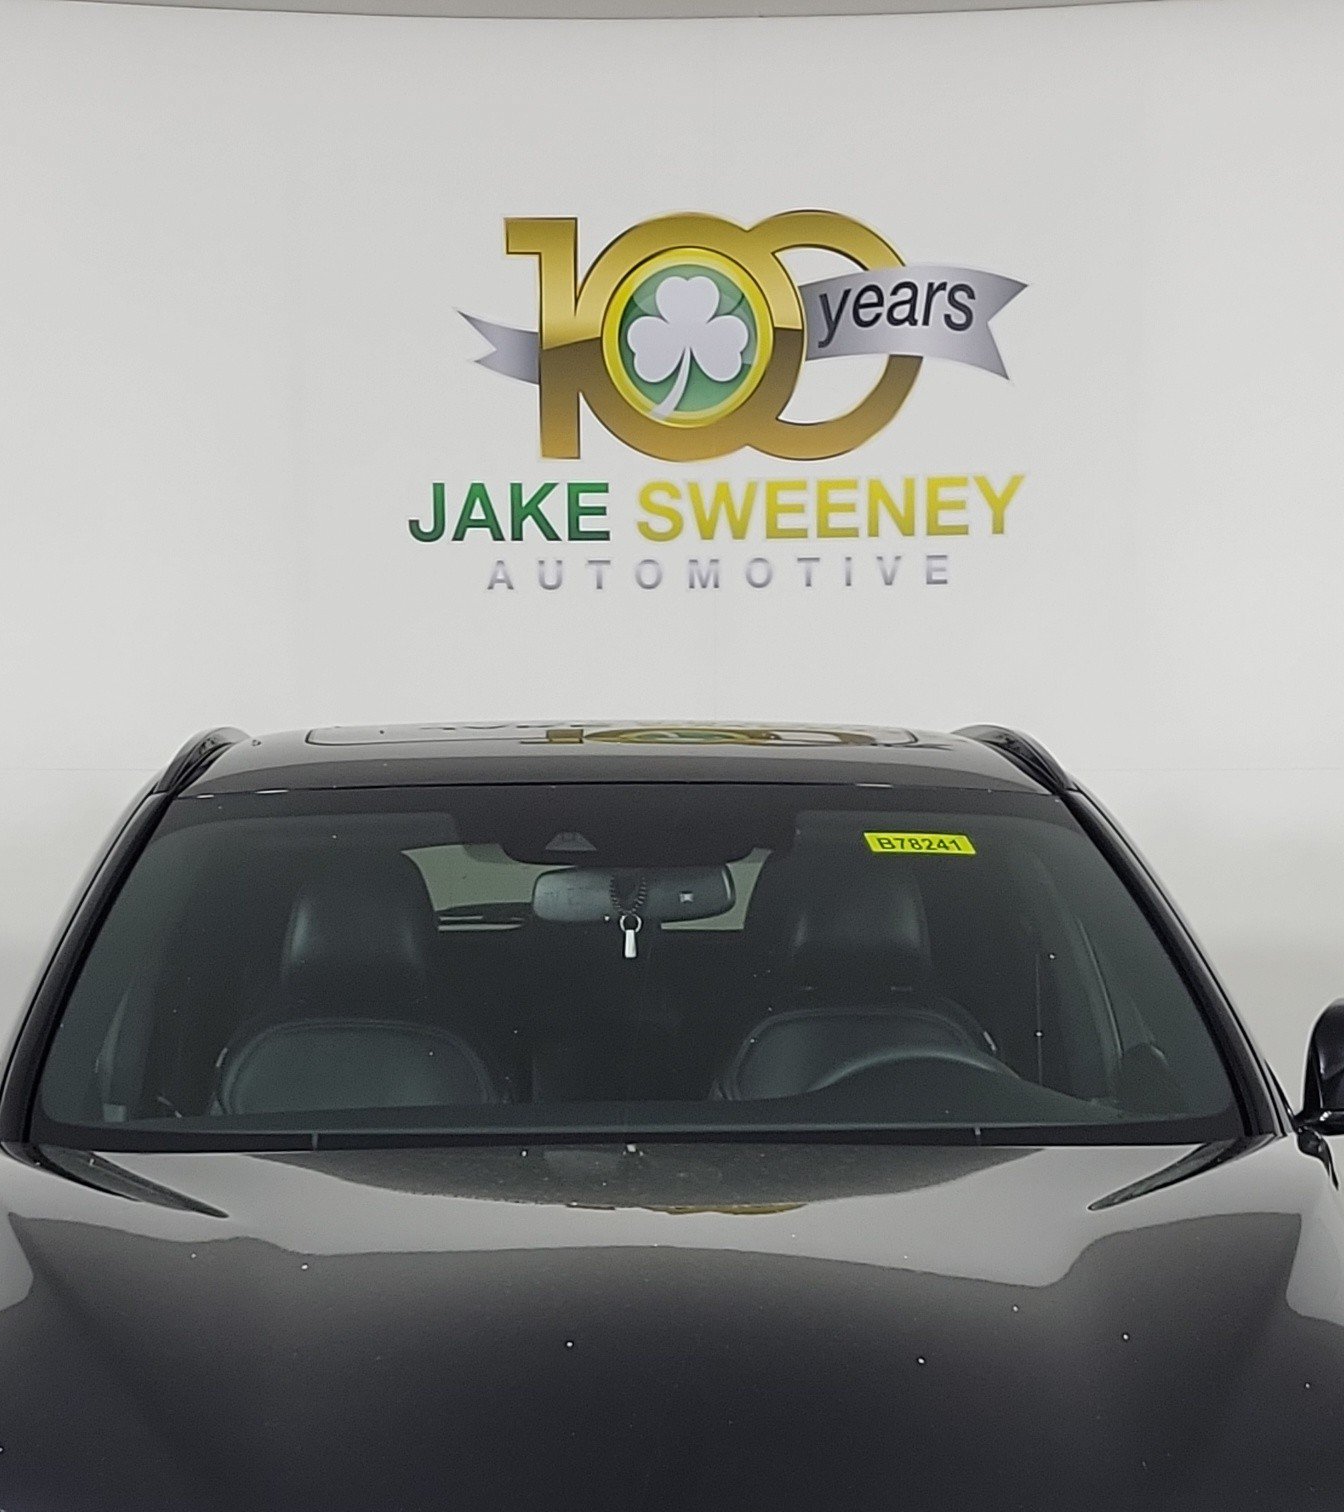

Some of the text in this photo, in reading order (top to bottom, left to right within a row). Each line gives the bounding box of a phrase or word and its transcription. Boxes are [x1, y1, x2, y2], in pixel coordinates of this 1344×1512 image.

[817, 280, 976, 349] years
[408, 475, 1025, 541] JAKE SWEENEY
[487, 555, 949, 590] AUTOMOTIVE
[877, 838, 962, 851] B78241
